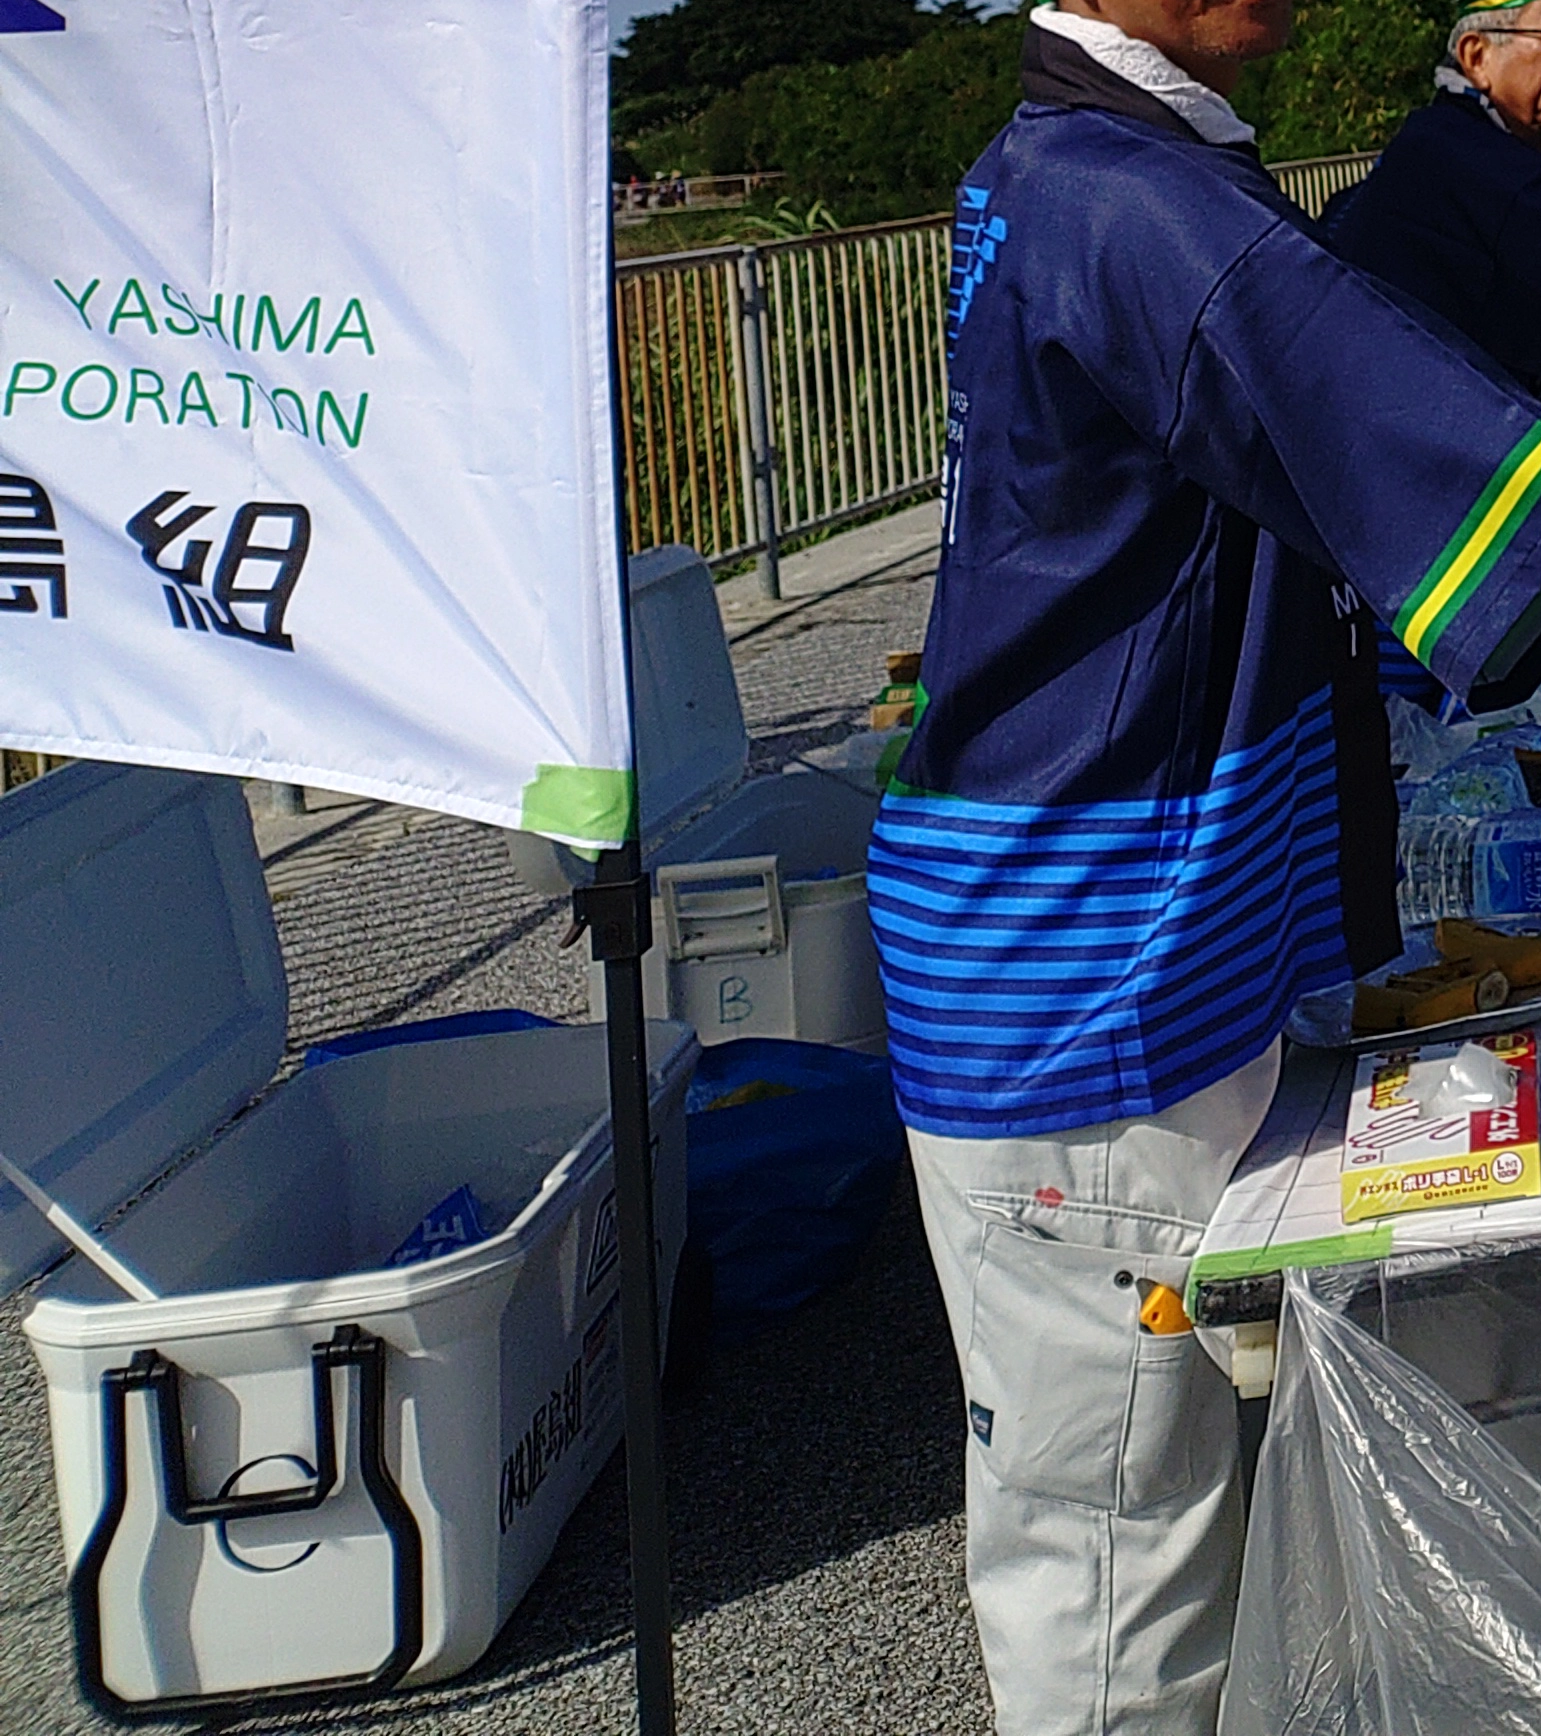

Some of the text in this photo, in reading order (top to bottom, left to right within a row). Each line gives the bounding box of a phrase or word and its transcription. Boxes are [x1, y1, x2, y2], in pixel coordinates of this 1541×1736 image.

[53, 278, 375, 356] YASHIMA
[719, 975, 753, 1024] B
[1401, 1168, 1461, 1192] ポリ手袋
